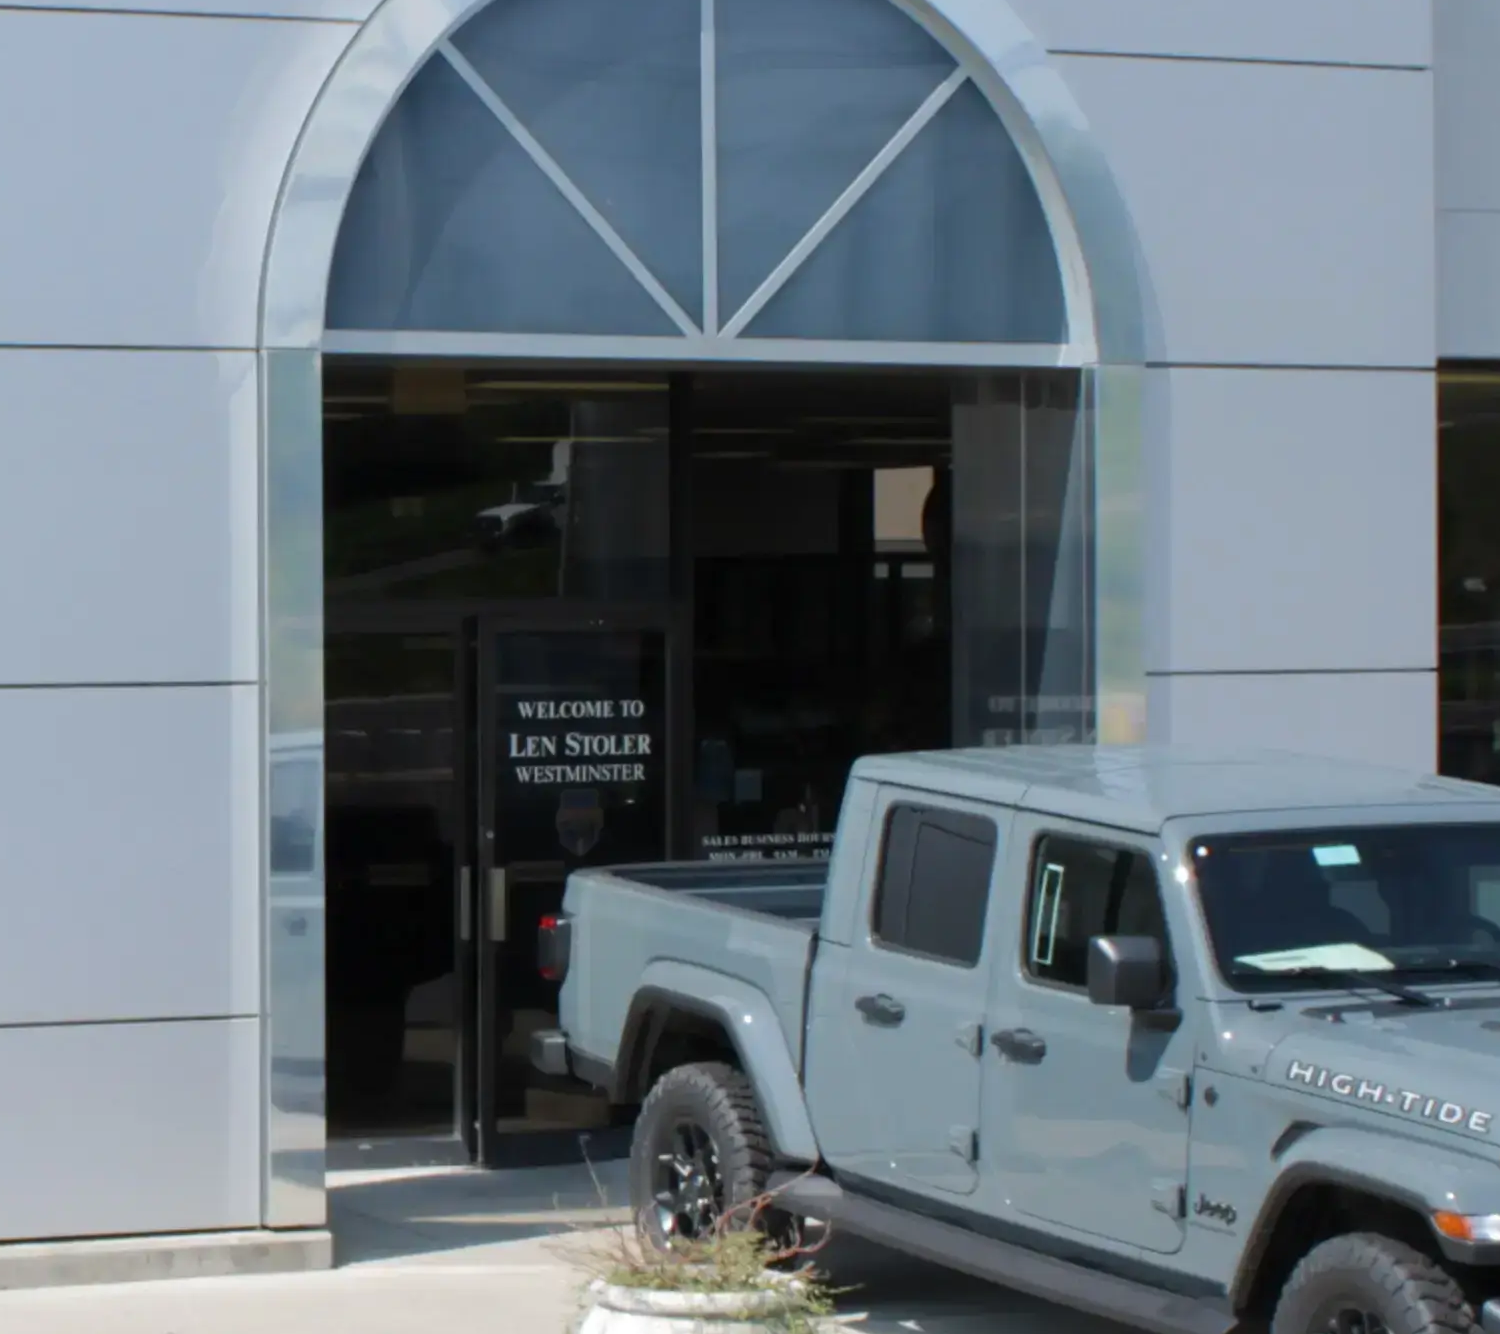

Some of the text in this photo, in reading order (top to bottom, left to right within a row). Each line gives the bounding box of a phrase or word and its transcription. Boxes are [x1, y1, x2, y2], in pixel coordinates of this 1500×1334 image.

[517, 699, 645, 719] WELCOME TO
[515, 764, 646, 784] WESTMINSTER
[1288, 1061, 1493, 1133] HIGH TIDE
[1193, 1192, 1238, 1227] Jeep
